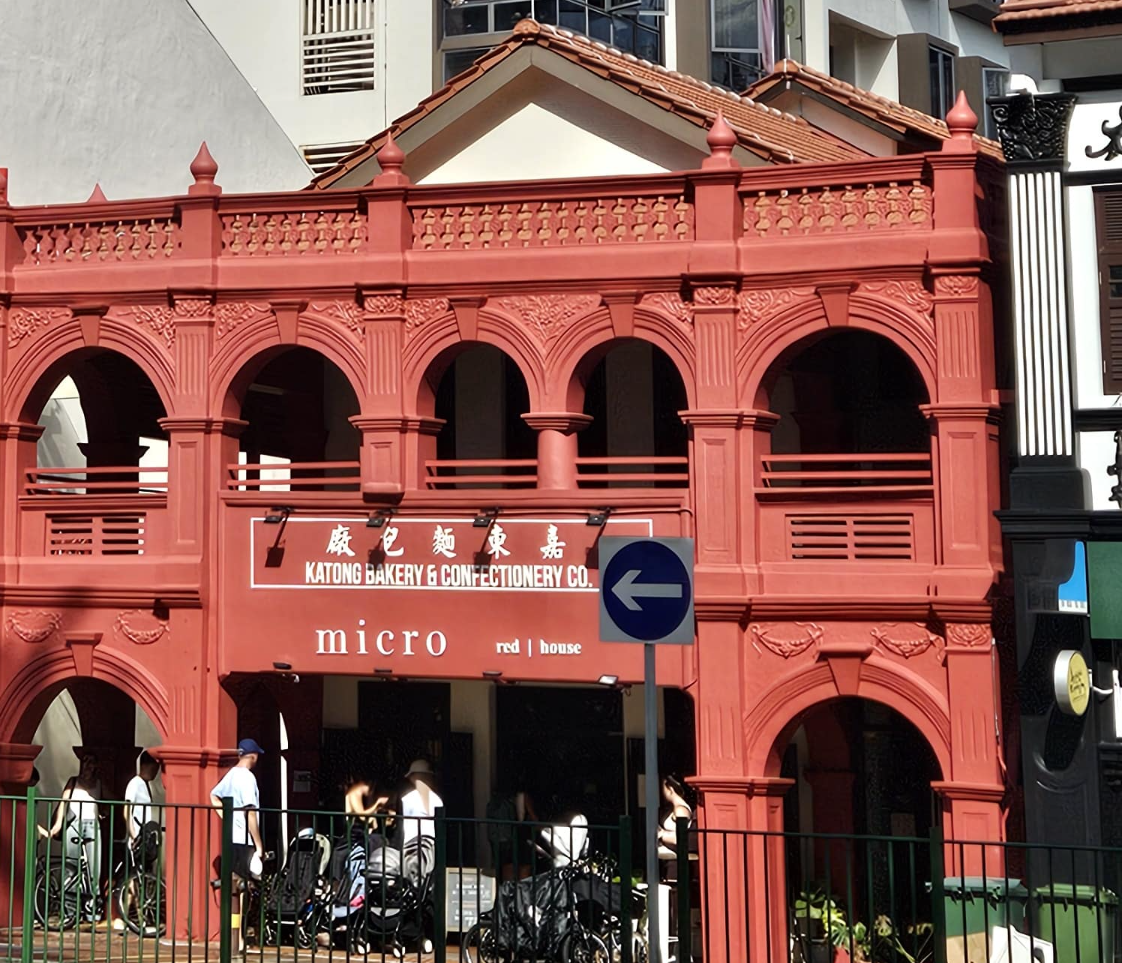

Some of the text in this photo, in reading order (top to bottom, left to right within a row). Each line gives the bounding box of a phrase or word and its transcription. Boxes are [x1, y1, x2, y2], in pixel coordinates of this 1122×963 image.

[305, 561, 594, 588] KATONG BAKERY & CONFECTIONERY CO.
[315, 619, 447, 656] micro
[496, 638, 520, 654] red
[539, 639, 582, 655] house
